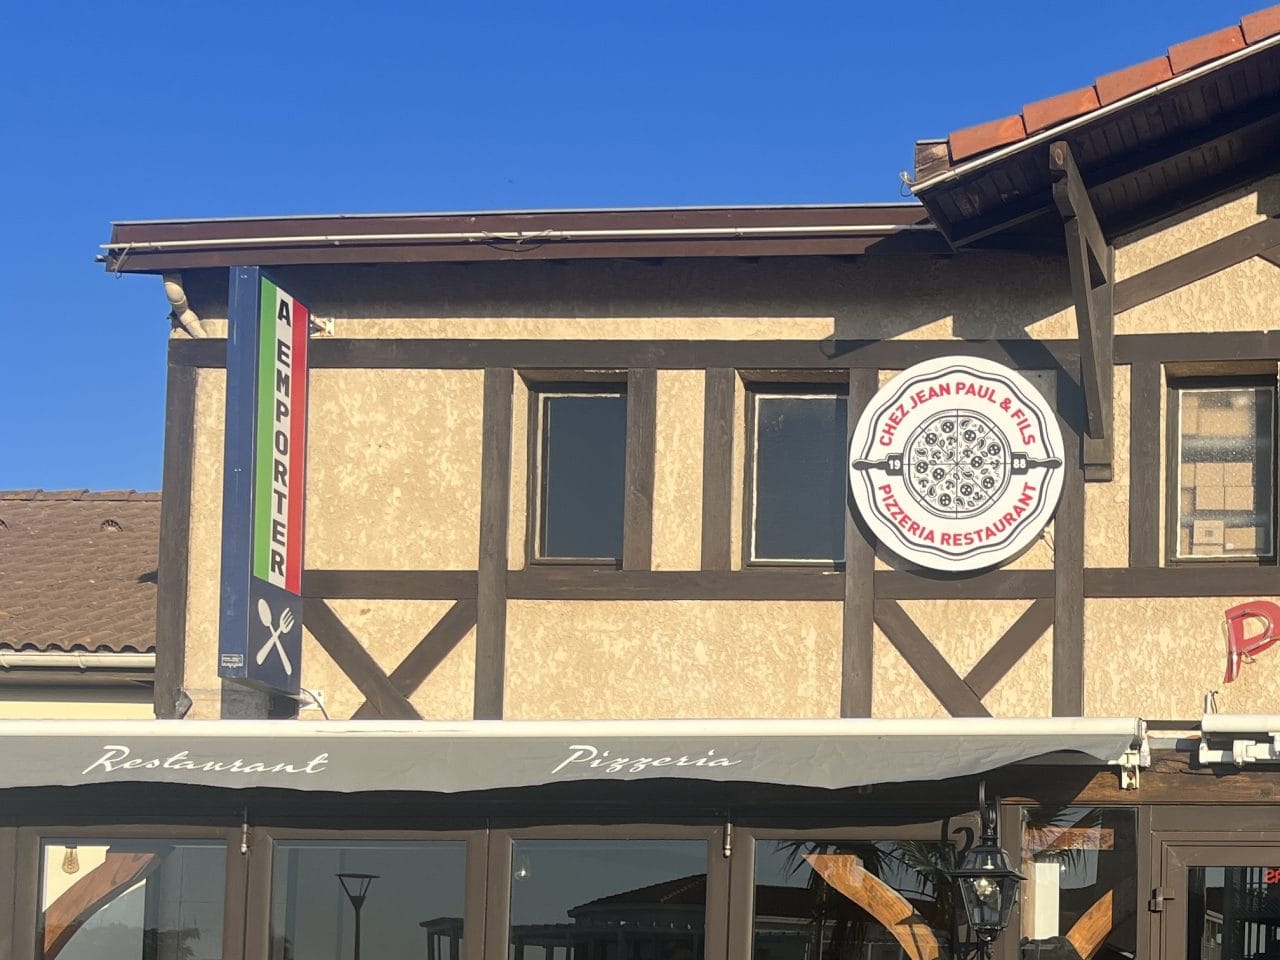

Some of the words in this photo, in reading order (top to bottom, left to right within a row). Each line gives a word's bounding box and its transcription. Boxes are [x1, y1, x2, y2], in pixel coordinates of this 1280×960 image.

[277, 298, 292, 327] A
[879, 404, 910, 446] CHEZ
[909, 383, 951, 408] JEAN
[956, 382, 997, 405] PAUL
[999, 397, 1012, 412] &
[1010, 409, 1036, 446] FILS
[270, 339, 291, 578] EMPORTER
[888, 459, 901, 471] 19
[1013, 458, 1027, 470] 88
[878, 484, 935, 544] PIZZERIA
[940, 482, 1037, 546] RESTAURANT
[81, 745, 329, 774] Restaurant
[551, 745, 742, 774] Pizzeria
